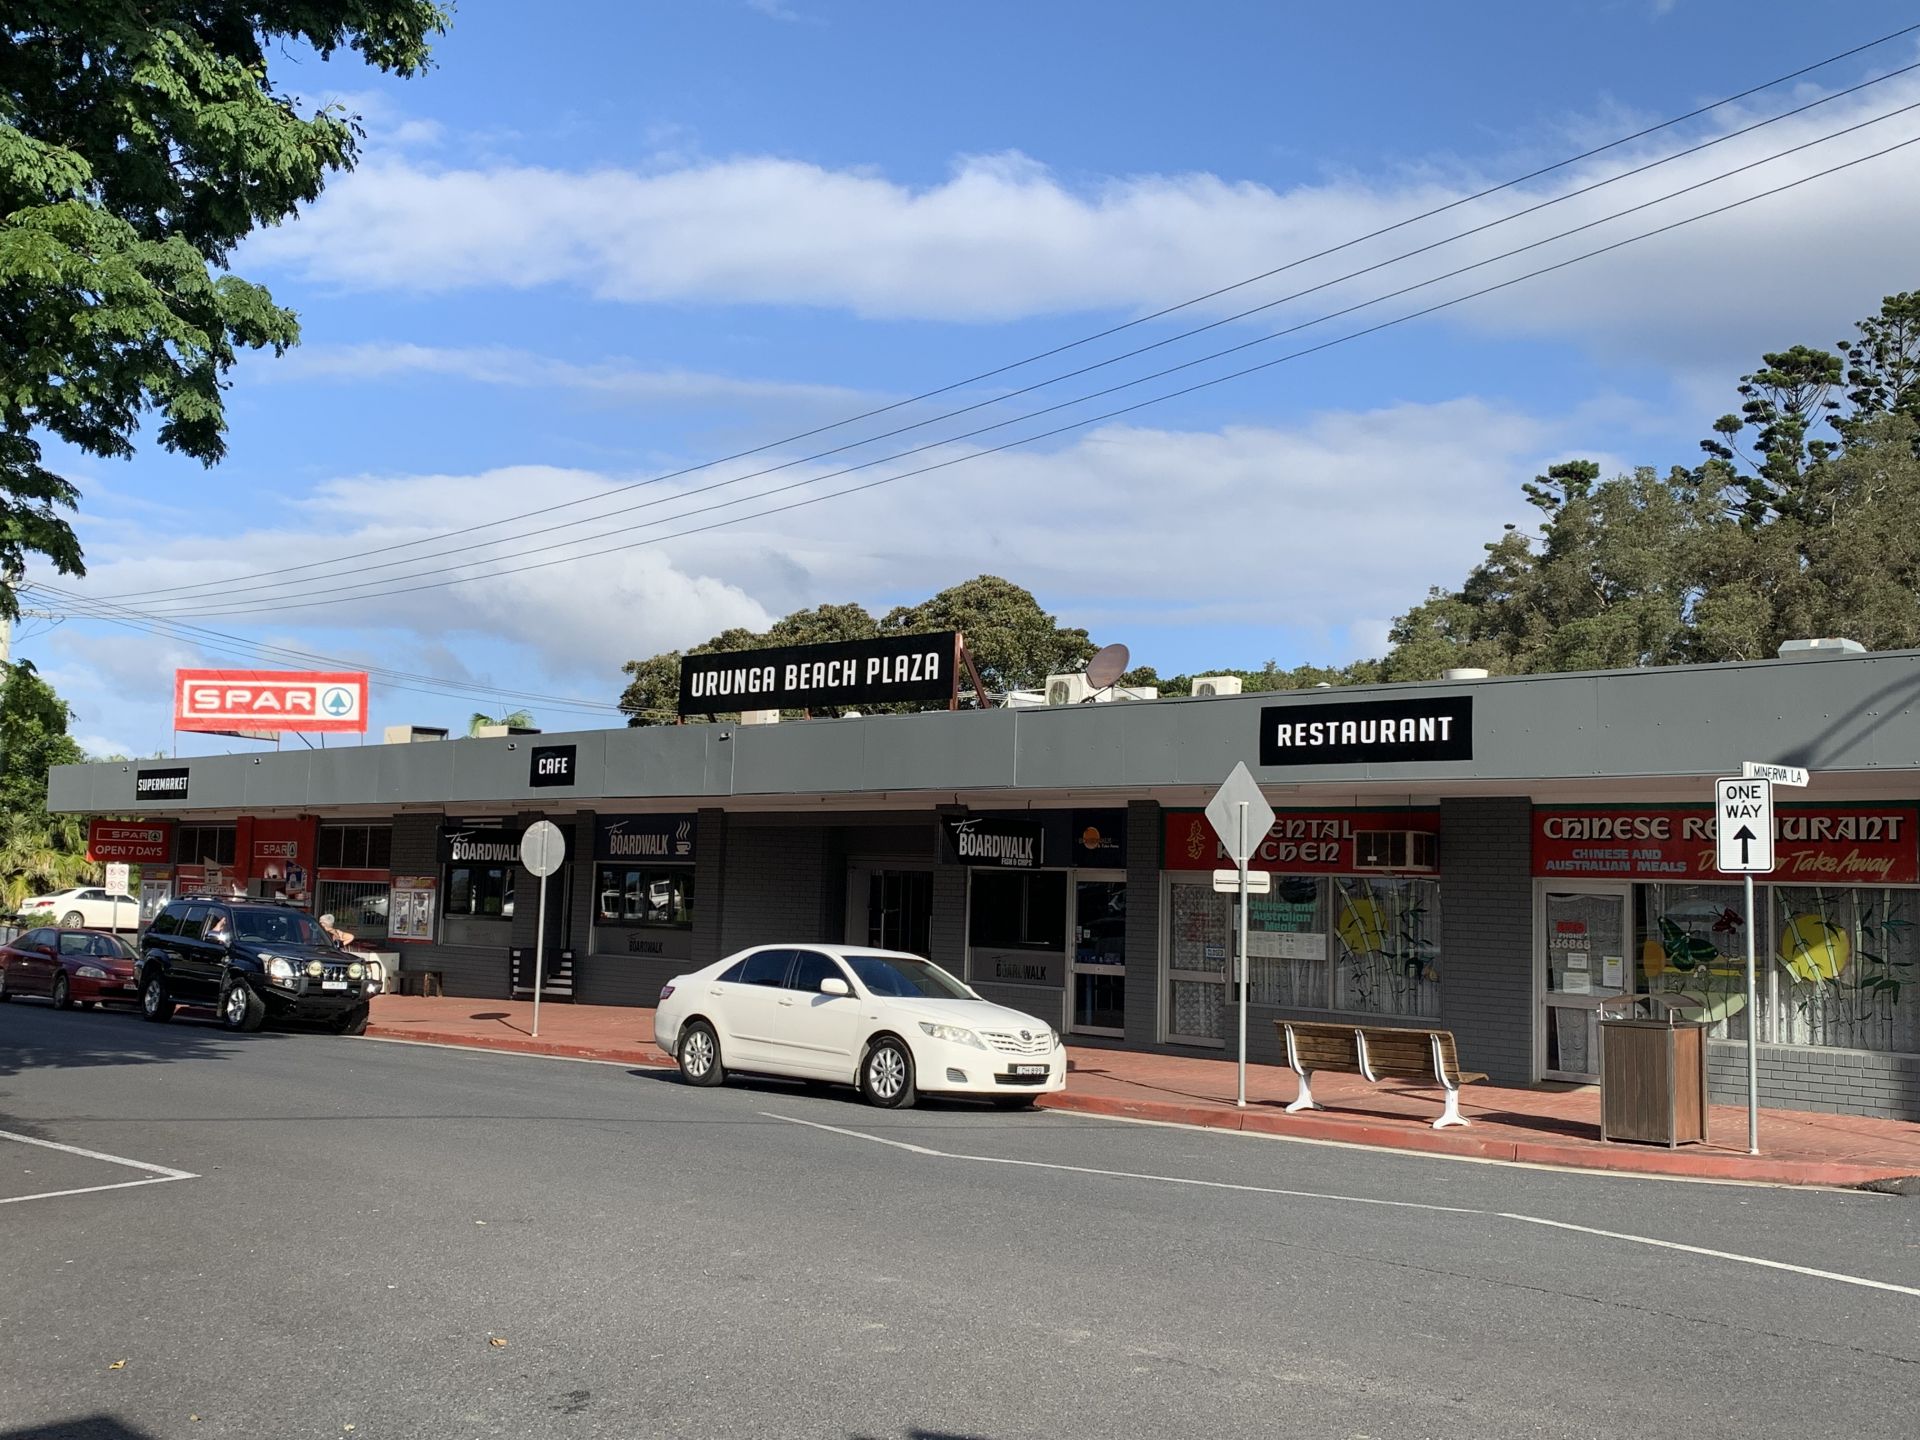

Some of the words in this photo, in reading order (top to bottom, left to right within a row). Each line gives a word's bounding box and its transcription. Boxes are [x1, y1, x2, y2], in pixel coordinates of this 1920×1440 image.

[691, 666, 775, 697] URUNGA
[784, 659, 856, 691] BEACH
[866, 652, 939, 685] PLAZA
[193, 688, 312, 710] SPAR
[1277, 716, 1453, 747] RESTAURANT
[538, 757, 568, 775] CAFE
[1753, 765, 1788, 782] MINERVA
[1791, 769, 1802, 783] LA
[137, 776, 187, 792] SUPERMARKET
[1726, 785, 1762, 800] ONE
[1725, 804, 1762, 819] WAY
[604, 820, 630, 836] The
[950, 818, 983, 834] The
[1268, 819, 1354, 839] ENTAL
[1543, 816, 1671, 841] CHINESE
[1683, 815, 1904, 841] REURANT
[111, 830, 148, 840] SPAR
[445, 830, 477, 844] The
[95, 844, 125, 856] OPEN
[127, 845, 134, 856] 7
[136, 846, 163, 857] DAYS
[263, 844, 287, 855] SPAR
[610, 834, 669, 855] BOARDWALK
[959, 833, 1034, 859] BOARDWALK
[1216, 841, 1340, 862] KCHEN
[1572, 848, 1629, 860] CHINESE
[1632, 849, 1662, 860] AND
[1546, 860, 1630, 871] AUSTRALIAN
[1637, 861, 1687, 872] MEALS
[1791, 850, 1838, 873] Take
[1836, 848, 1896, 880] Away
[1252, 911, 1311, 921] Australian
